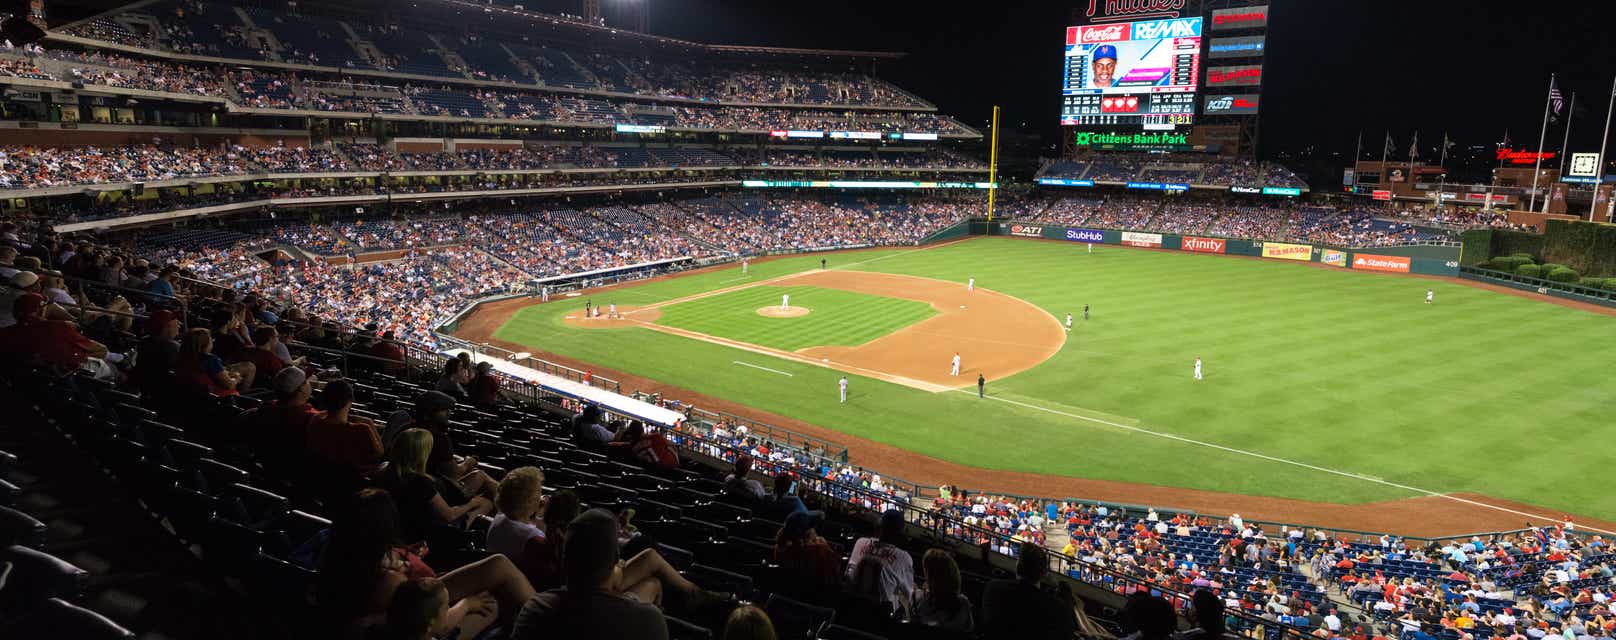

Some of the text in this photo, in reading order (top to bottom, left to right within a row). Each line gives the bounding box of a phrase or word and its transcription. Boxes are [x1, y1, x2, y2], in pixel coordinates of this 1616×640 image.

[1135, 19, 1199, 39] RE/MAX
[1092, 134, 1186, 144] Citizens Bank Park
[1021, 226, 1042, 234] ATI
[1067, 230, 1103, 240] StubHub
[1185, 239, 1222, 252] xfinity
